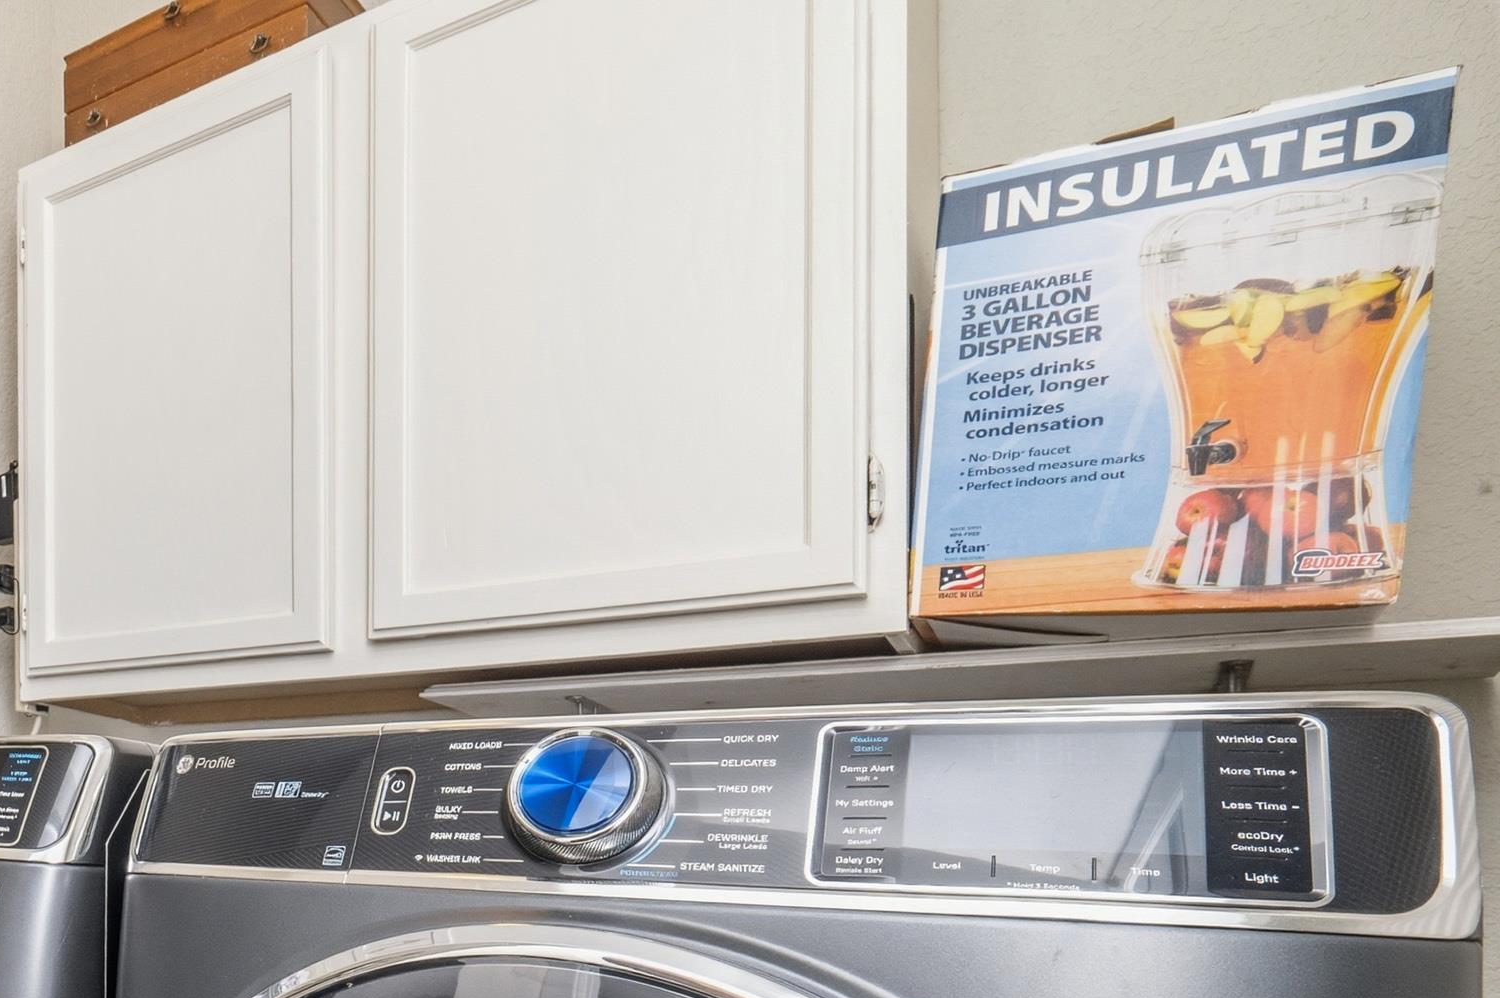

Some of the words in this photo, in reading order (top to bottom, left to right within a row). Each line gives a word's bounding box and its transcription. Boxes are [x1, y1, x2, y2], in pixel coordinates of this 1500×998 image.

[983, 110, 1415, 232] INSULATED
[963, 269, 1093, 301] UNBREAKABLE
[961, 305, 977, 321] 3
[983, 285, 1091, 317] GALLON
[960, 304, 1100, 341] BEVERAGE
[958, 325, 1103, 361] DISPENSER
[966, 368, 1025, 386] Keeps
[1030, 358, 1096, 377] drinks
[969, 383, 1035, 402] colder,
[1040, 374, 1110, 393] longer
[963, 402, 1065, 424] Minimizes
[965, 415, 1104, 440] condensation
[1028, 445, 1072, 457] faucet
[967, 462, 1035, 477] Embossed
[1038, 459, 1098, 471] measure
[1101, 453, 1146, 466] marks
[966, 479, 1013, 491] Perfect
[1015, 475, 1067, 488] indoors
[1070, 471, 1097, 483] and
[1100, 470, 1125, 481] out
[1300, 552, 1384, 570] BUDDEEZ
[723, 735, 754, 744] QUICK
[756, 734, 780, 743] DRY
[1216, 735, 1263, 744] Wrinkle
[1267, 735, 1298, 744] Care
[195, 756, 236, 769] Profile
[444, 763, 482, 771] COTTONS
[720, 759, 778, 767] DELICATES
[870, 764, 895, 773] Alert
[1219, 767, 1251, 776] More
[1253, 767, 1286, 776] Time
[440, 786, 473, 794] TOWELS
[717, 785, 748, 793] TIMED
[751, 785, 774, 793] DRY
[835, 799, 849, 808] My
[851, 798, 895, 808] Settings
[1255, 801, 1287, 811] Time
[723, 808, 771, 817] REFRESH
[707, 833, 769, 843] DEWRINKLE
[1237, 831, 1284, 842] ecoDry
[865, 856, 884, 866] Dry
[932, 861, 961, 870] Level
[679, 862, 715, 871] STEAM
[717, 863, 765, 873] SANITIZE
[1029, 863, 1061, 874] Temp
[1244, 873, 1279, 884] Light
